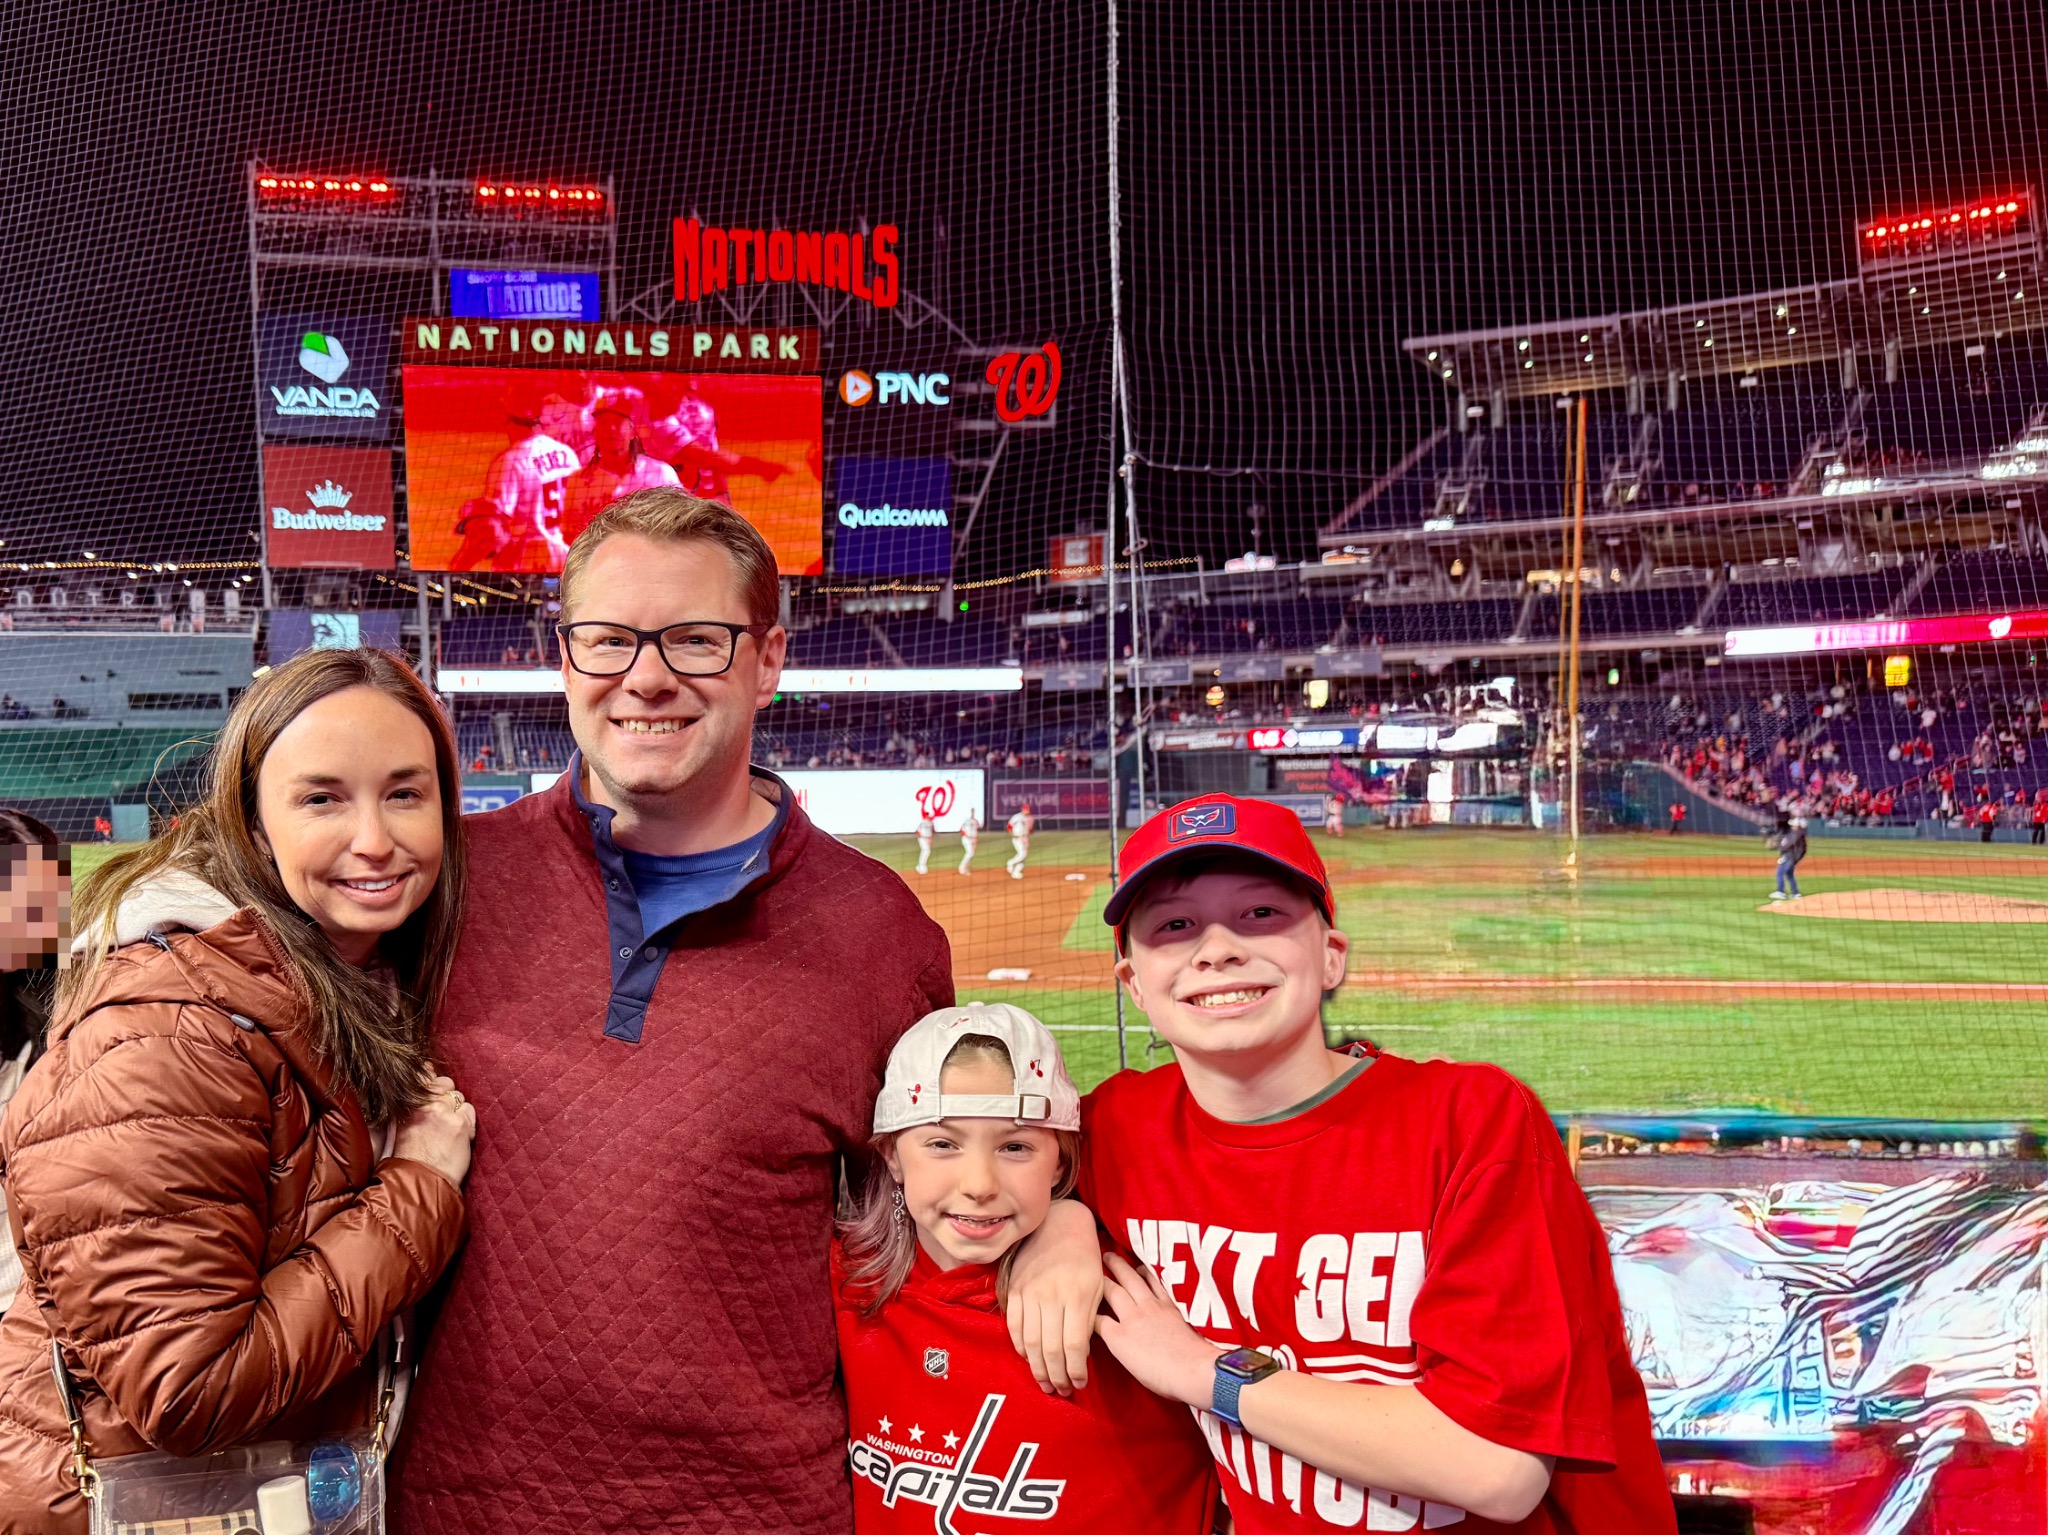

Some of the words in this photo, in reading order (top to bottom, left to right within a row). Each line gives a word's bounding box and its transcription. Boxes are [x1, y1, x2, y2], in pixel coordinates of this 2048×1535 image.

[673, 217, 899, 308] NATIONALS
[417, 324, 670, 358] NATIONALS
[693, 331, 800, 361] PARK
[270, 386, 381, 410] VANDA
[875, 372, 950, 405] PNC
[271, 507, 387, 531] Budweiser
[838, 502, 949, 529] Qualcomm
[1126, 1218, 1277, 1333] NEXT
[927, 1353, 945, 1371] NHL
[848, 1393, 1067, 1535] capitals
[866, 1432, 955, 1466] WASHINGTON
